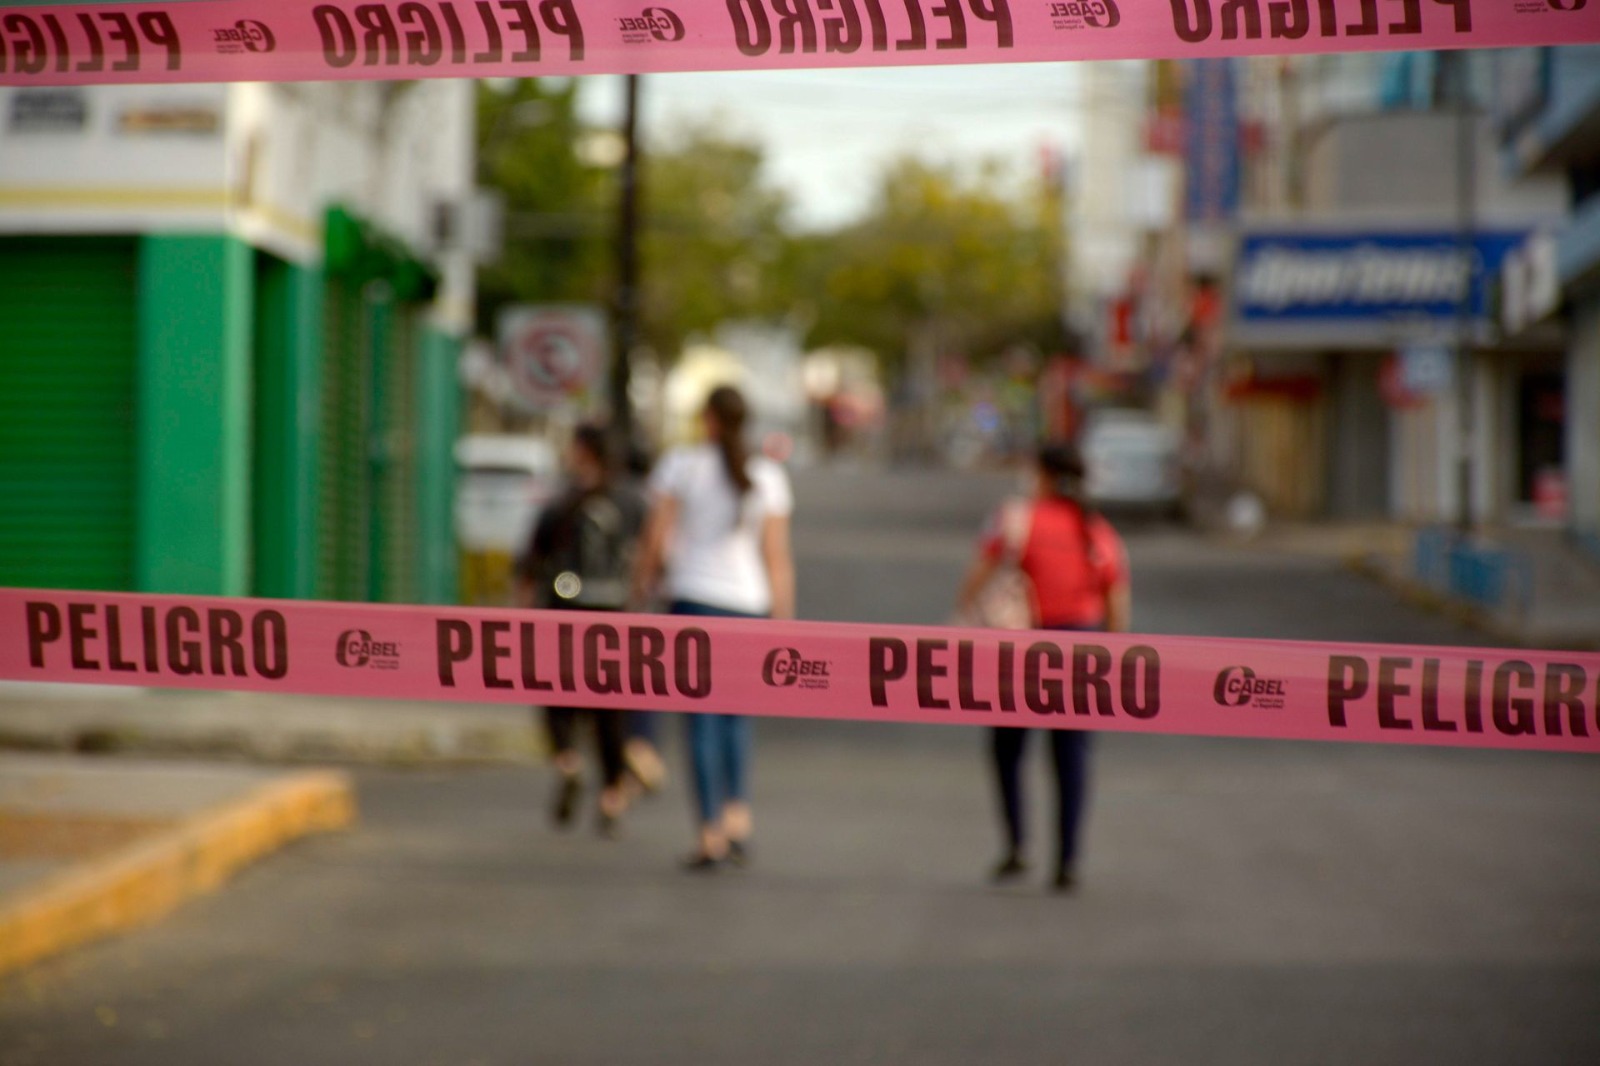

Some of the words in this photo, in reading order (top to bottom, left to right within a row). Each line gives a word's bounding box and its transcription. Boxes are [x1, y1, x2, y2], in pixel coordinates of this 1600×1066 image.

[25, 601, 288, 680] PELIGRO
[436, 618, 713, 700] PELIGRO
[868, 637, 1161, 719] PELIGRO
[1327, 654, 1600, 738] PELIGR
